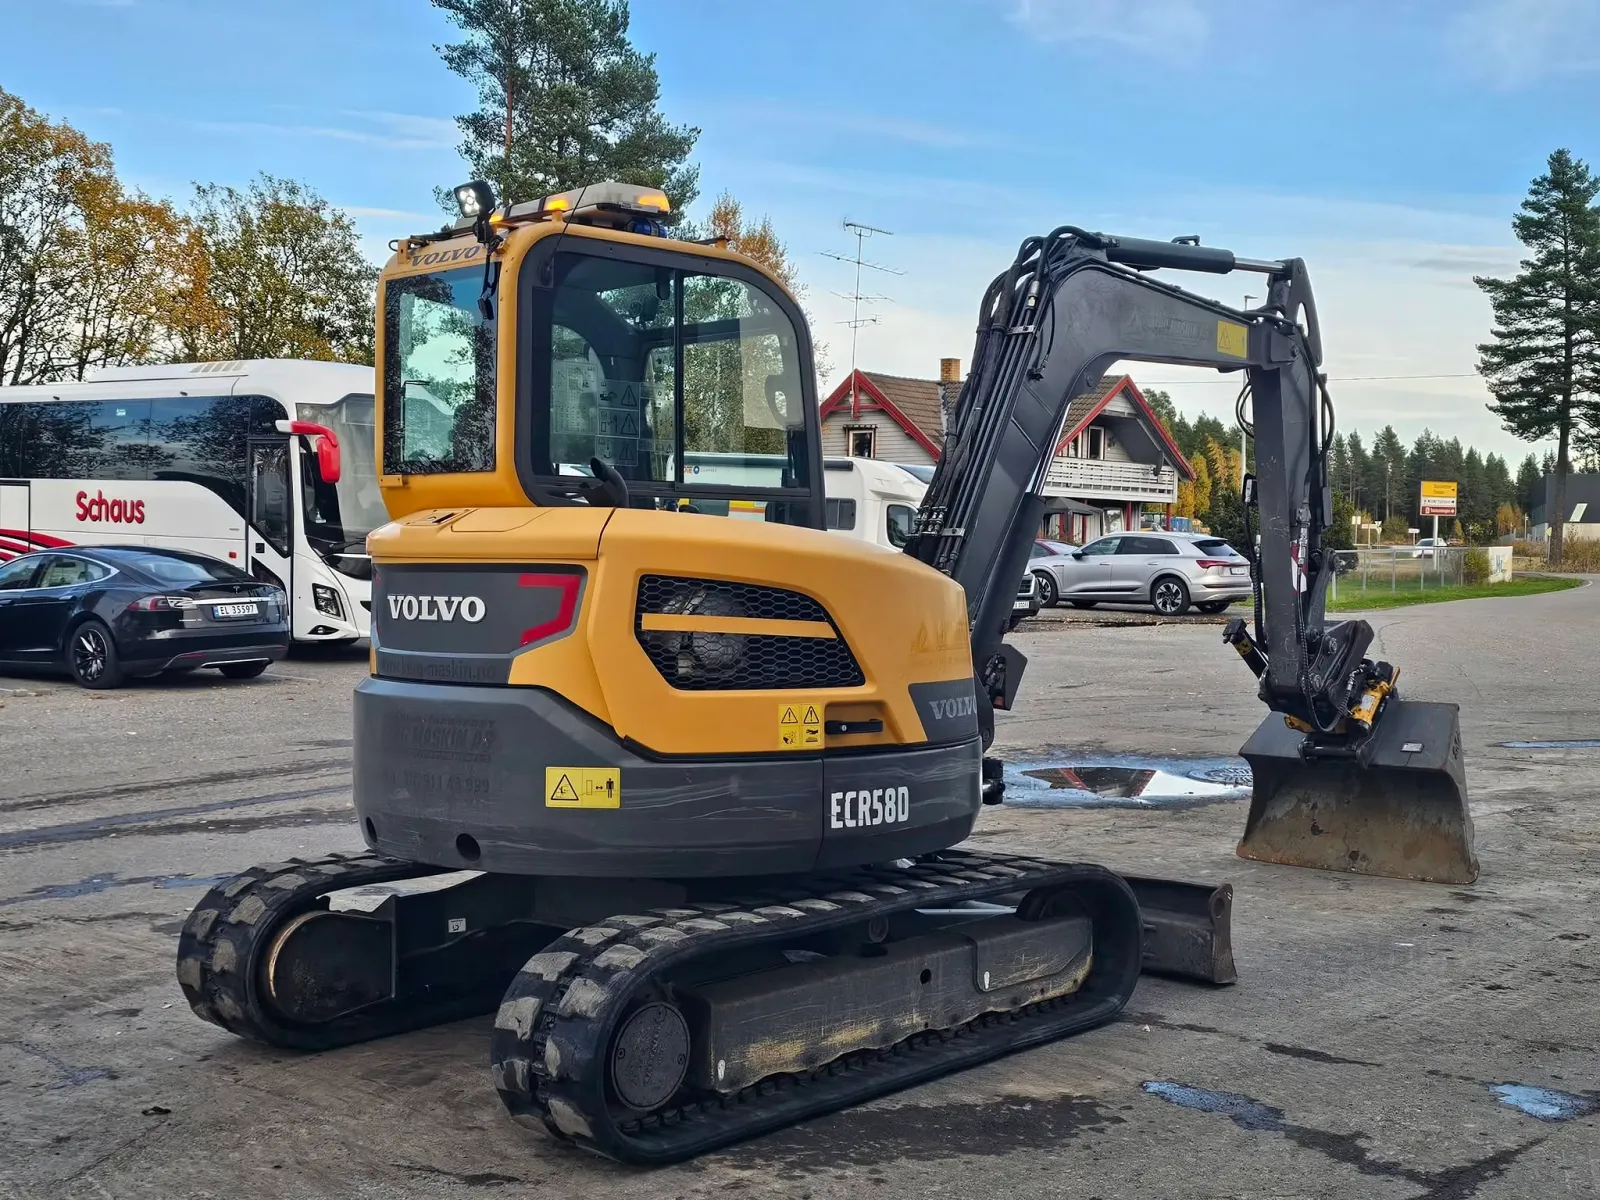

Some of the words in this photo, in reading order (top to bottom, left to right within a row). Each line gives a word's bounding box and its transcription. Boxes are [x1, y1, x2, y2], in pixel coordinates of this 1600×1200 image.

[412, 245, 480, 267] VOLVO
[75, 489, 145, 525] Schaus
[220, 606, 229, 614] EL
[231, 604, 254, 614] 35597
[387, 594, 486, 622] VOLVO
[830, 785, 910, 829] ECR58D
